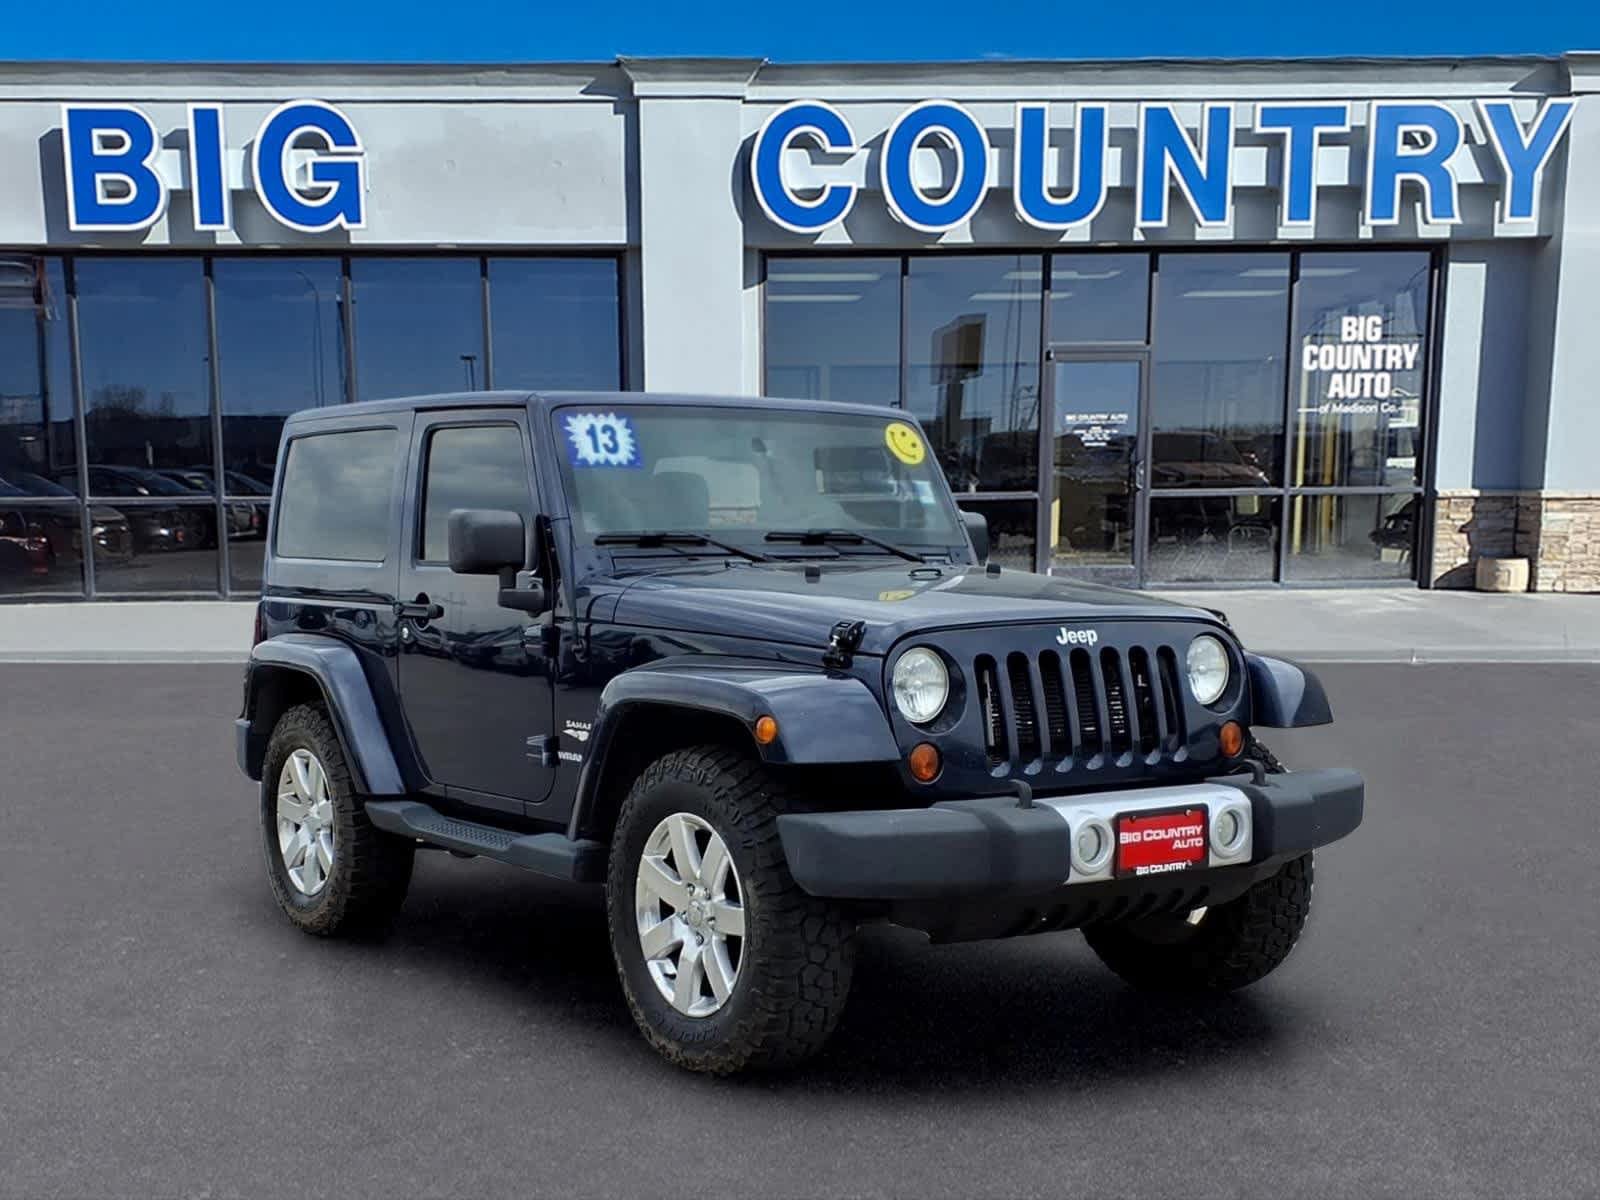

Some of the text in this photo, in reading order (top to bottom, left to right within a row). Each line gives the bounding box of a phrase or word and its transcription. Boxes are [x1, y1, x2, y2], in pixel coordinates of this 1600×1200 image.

[61, 98, 1577, 234] BIG COUNTRY
[1341, 315, 1383, 342] BIG
[1302, 342, 1419, 371] COUNTRY
[1327, 372, 1391, 399] AUTO
[1319, 403, 1331, 414] of
[1331, 402, 1378, 414] Madison
[585, 423, 619, 455] 13
[1056, 627, 1098, 646] Jeep
[1120, 825, 1203, 844] BIG COUNTRY
[1172, 838, 1204, 850] AUTO
[1136, 861, 1186, 875] BIG COUNTRY
